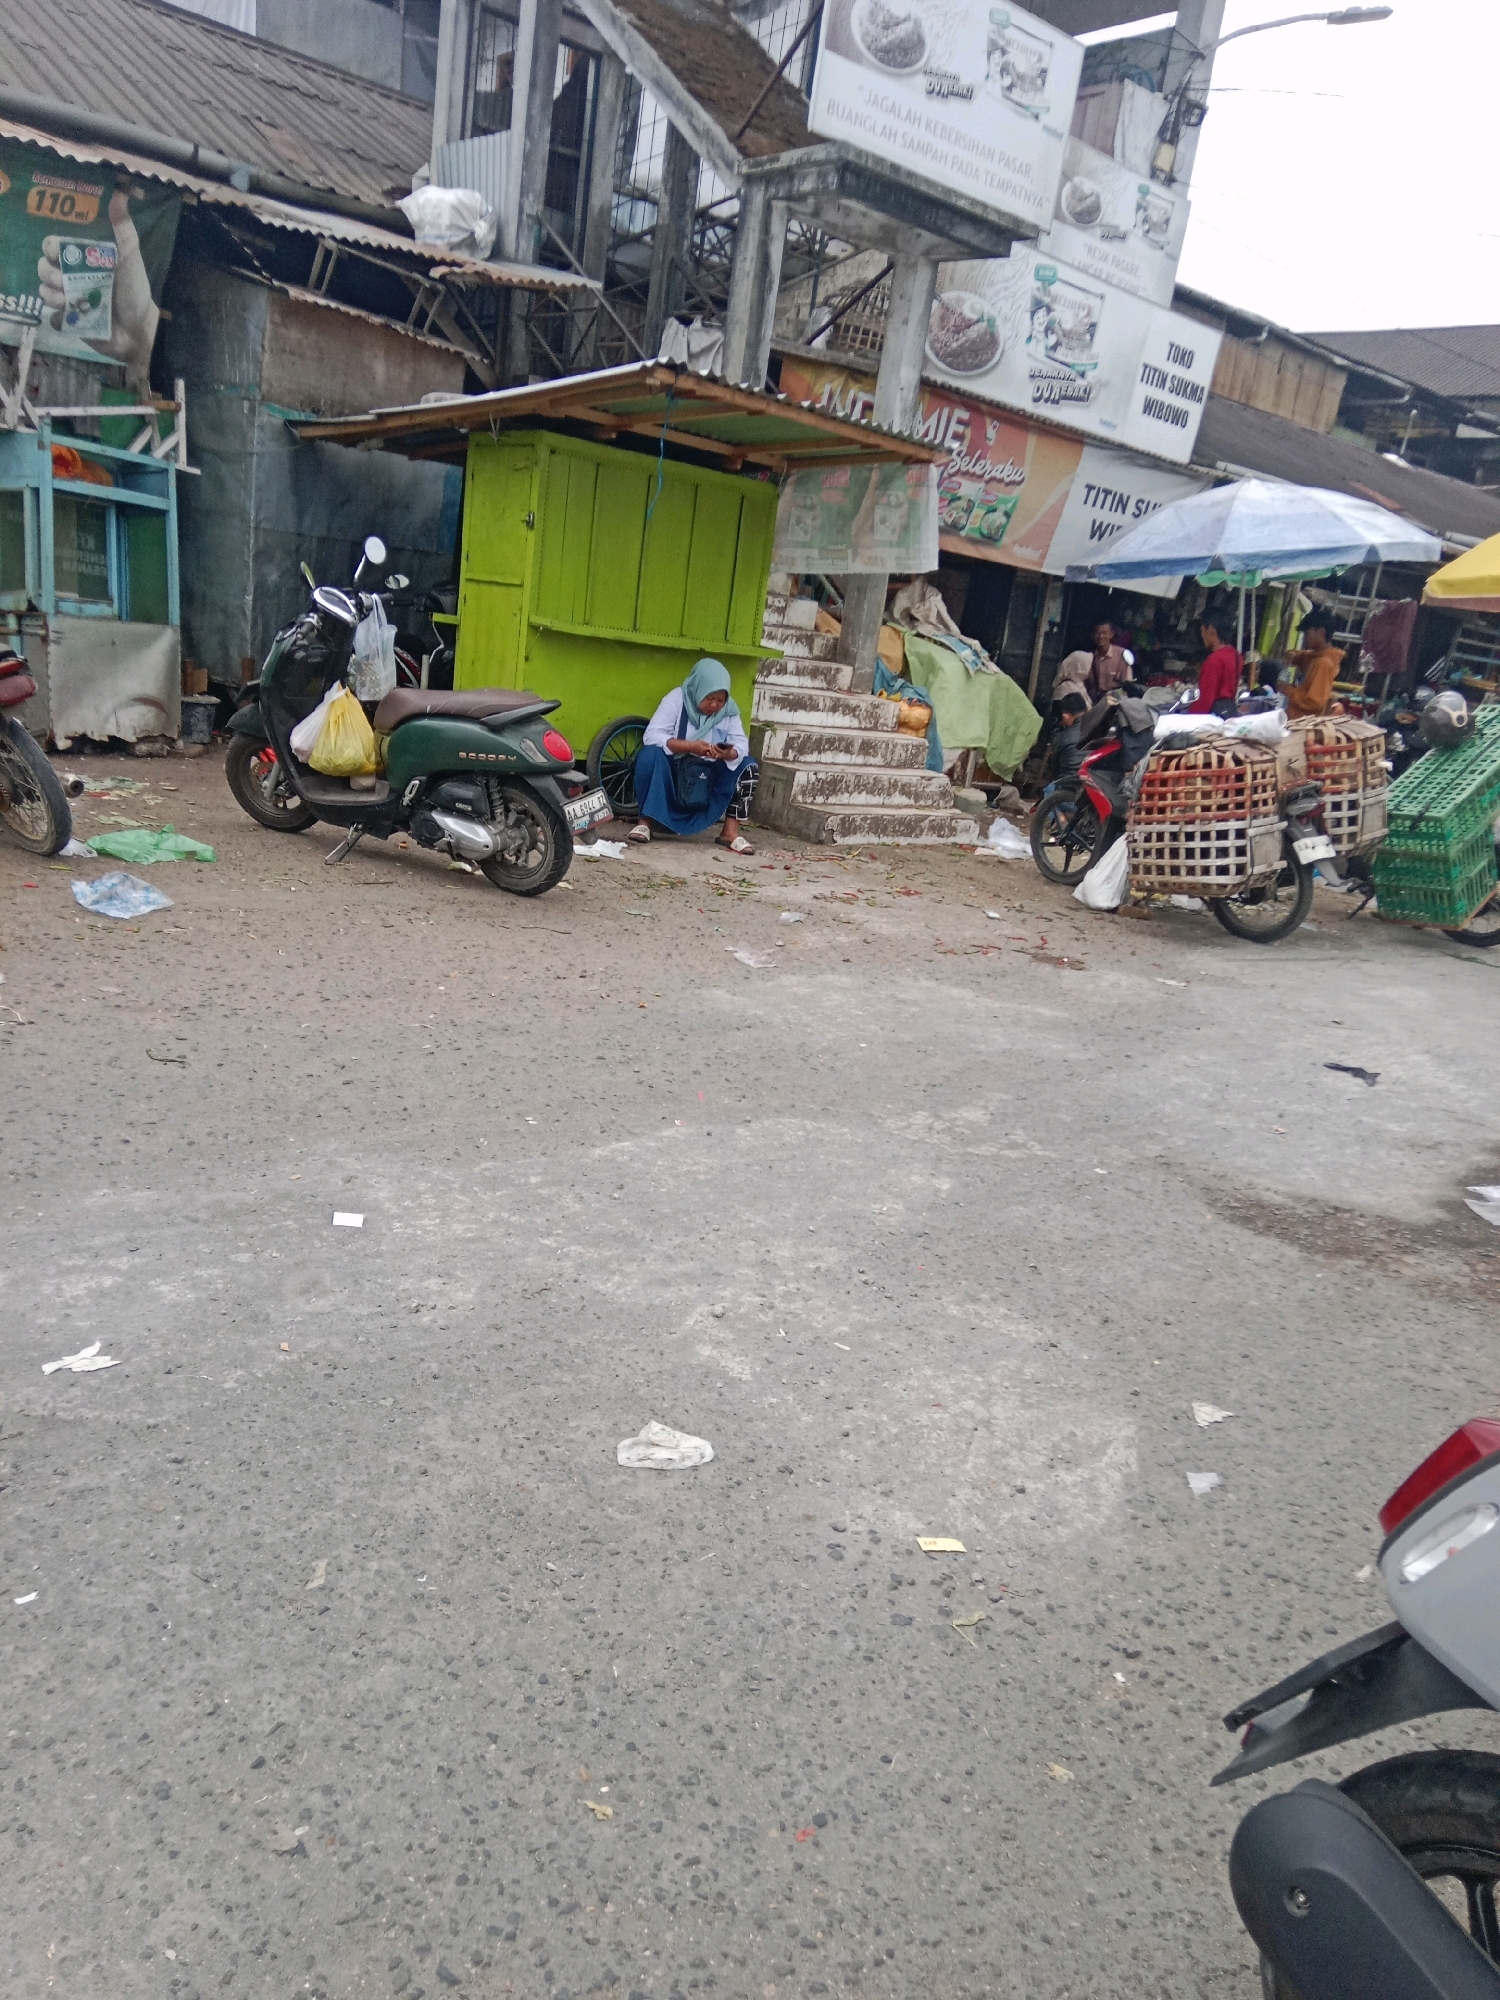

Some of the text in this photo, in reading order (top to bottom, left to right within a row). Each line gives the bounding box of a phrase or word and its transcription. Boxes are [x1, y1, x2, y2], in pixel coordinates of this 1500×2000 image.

[827, 98, 898, 145] BUANGLAH
[901, 131, 949, 168] SAMPAH
[951, 154, 981, 183] PADA
[925, 115, 997, 163] KEBERSIHAN
[1167, 340, 1195, 370] TOKO
[1140, 362, 1206, 405] TITIN SUKMA
[1142, 395, 1190, 429] WIBOWO
[948, 449, 1025, 486] Seleraku
[1083, 483, 1131, 515] TITIN
